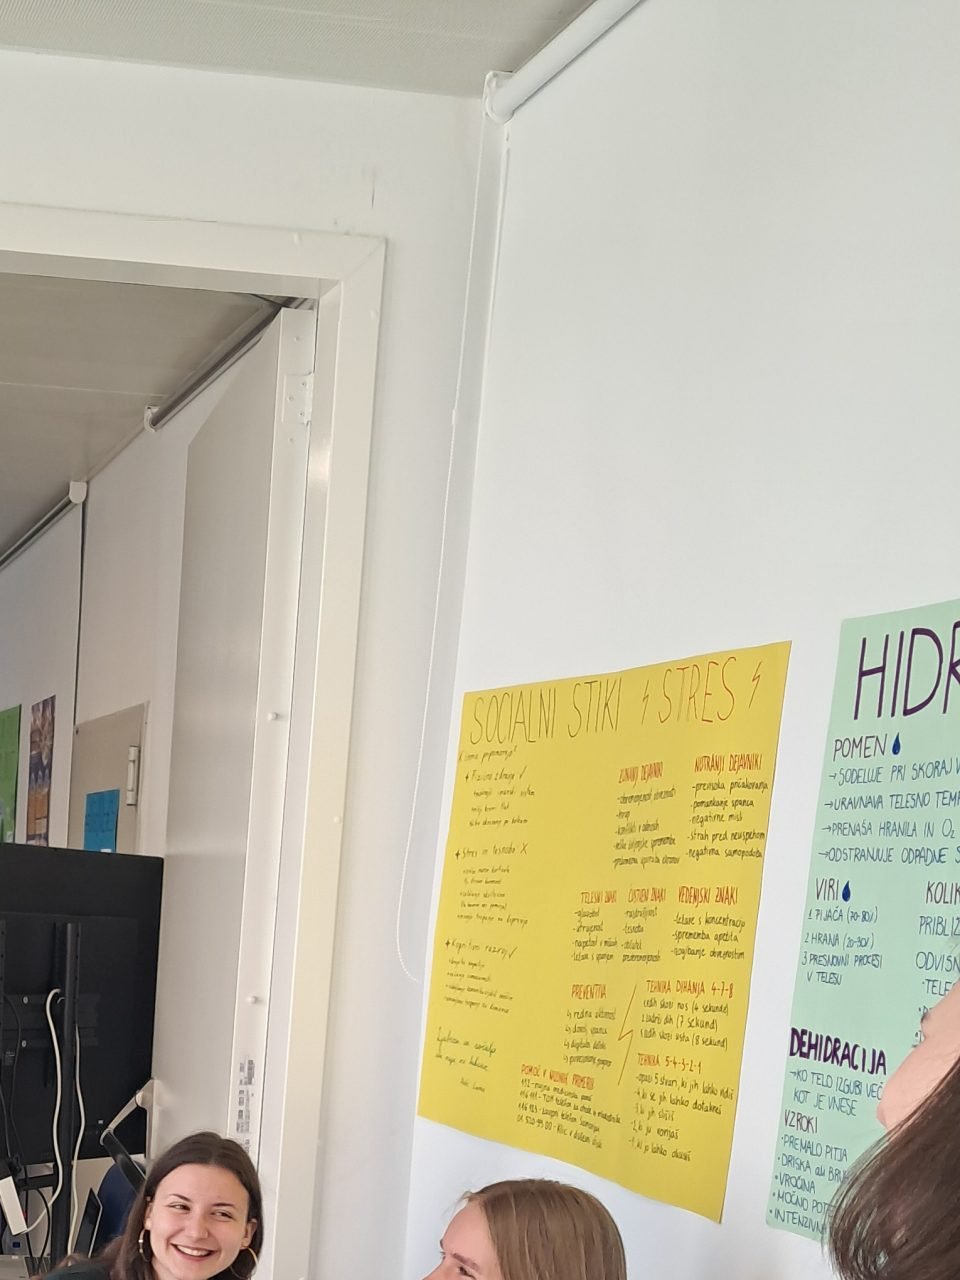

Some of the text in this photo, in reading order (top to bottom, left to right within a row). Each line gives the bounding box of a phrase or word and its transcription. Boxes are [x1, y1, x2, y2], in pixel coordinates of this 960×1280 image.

[470, 656, 737, 745] SOCIALNI STIKI STRES
[833, 733, 888, 762] POMEN
[891, 765, 906, 783] PRI
[911, 757, 953, 780] SKORAJ
[732, 799, 754, 810] spanca
[834, 795, 884, 811] URAVNAVA
[889, 792, 931, 809] TELESNO
[711, 830, 728, 844] pred
[832, 819, 872, 836] PRENAŠA
[878, 820, 917, 838] HRANILA
[924, 821, 935, 838] IN
[901, 847, 950, 866] ODPADNE
[715, 885, 739, 905] ZNAKI
[816, 878, 839, 901] VIRI
[815, 905, 843, 922] PIJAČA
[811, 932, 840, 947] HRANA
[854, 953, 883, 969] PROCESI
[807, 971, 842, 985] V TELESU
[676, 980, 705, 998] DIHANJA
[711, 981, 734, 999] 4-7-8
[677, 1002, 689, 1011] nos
[687, 1016, 718, 1032] sekund)
[789, 1027, 886, 1076] DEHIDRACIJA
[811, 1072, 833, 1089] TELO
[836, 1076, 862, 1096] IZGUBI
[866, 1081, 884, 1101] VEČ
[669, 1093, 690, 1107] lahko
[794, 1088, 858, 1116] KOT JE VNESE
[784, 1109, 818, 1134] VZROKI
[784, 1134, 848, 1162] PREMALO PITJA
[782, 1153, 811, 1174] DRISKA
[779, 1171, 816, 1195] VROČINA
[777, 1189, 809, 1211] MOČNO
